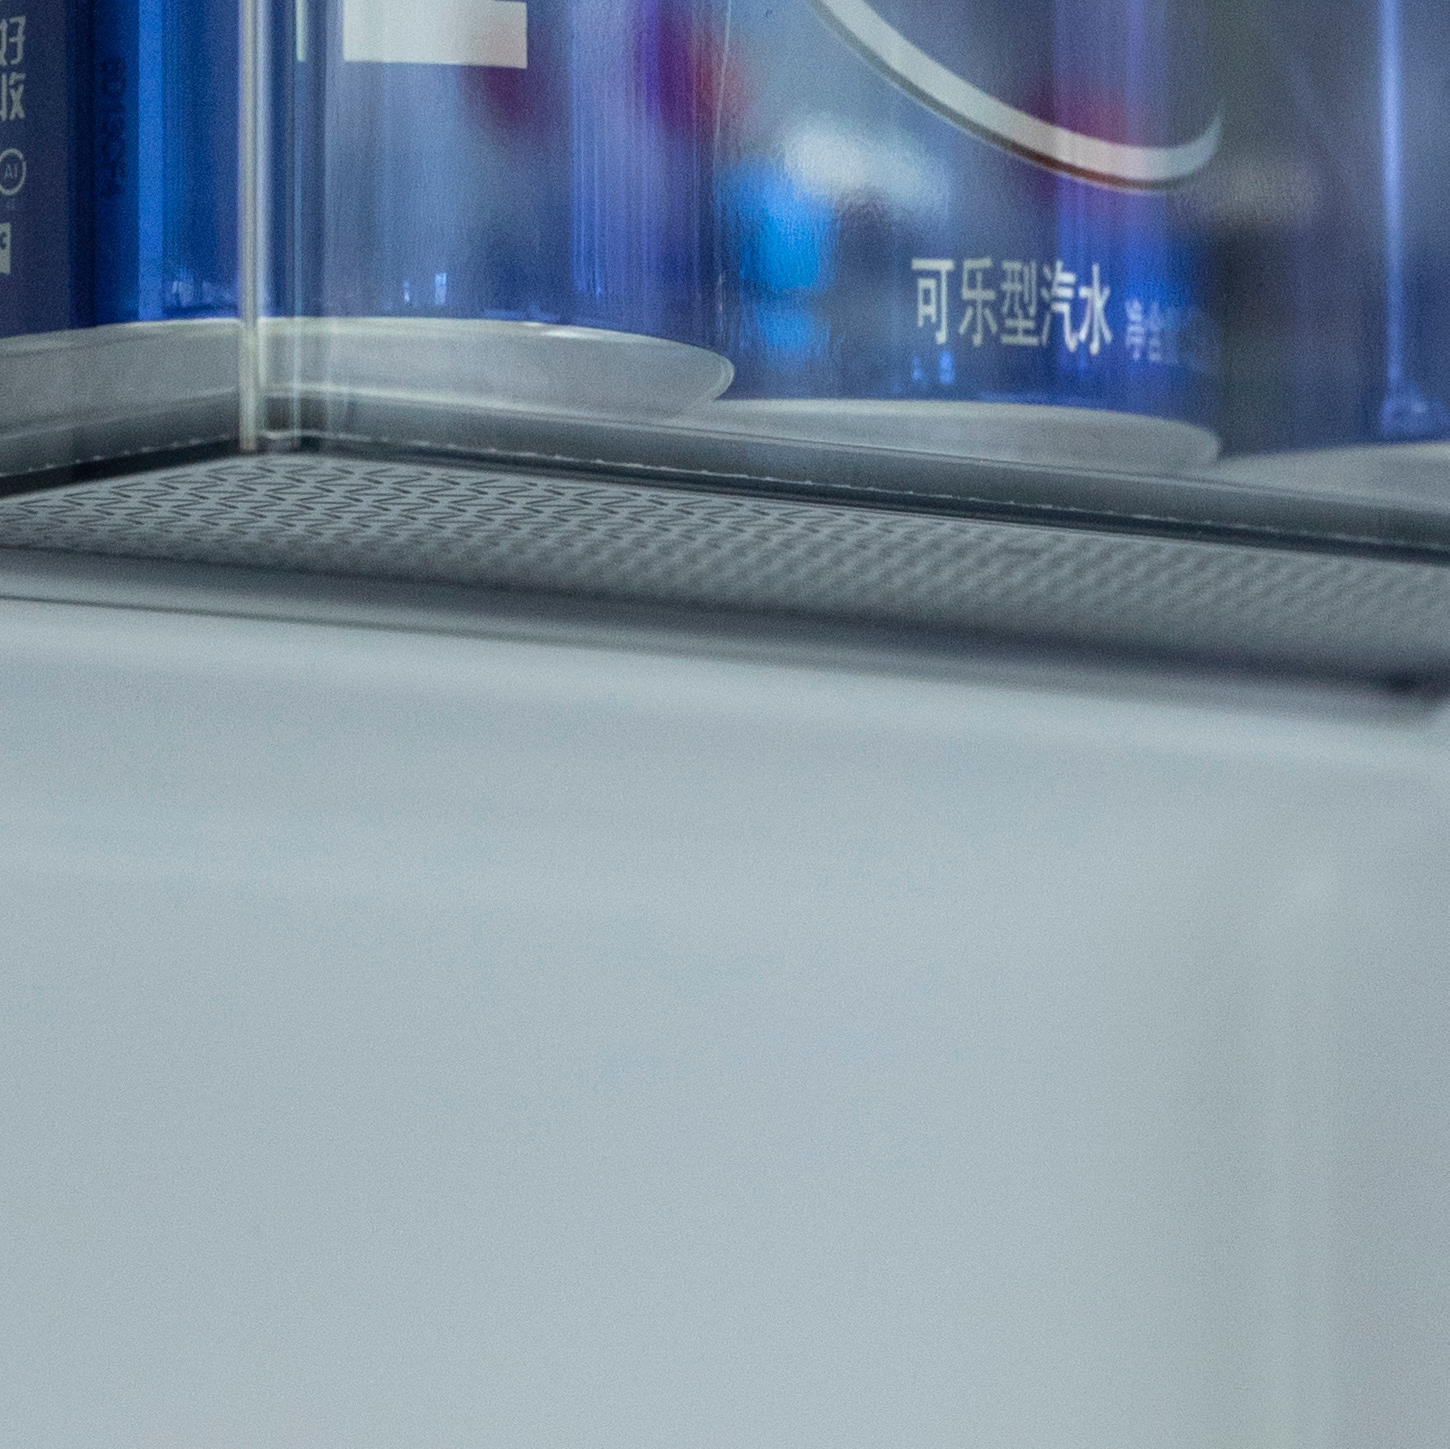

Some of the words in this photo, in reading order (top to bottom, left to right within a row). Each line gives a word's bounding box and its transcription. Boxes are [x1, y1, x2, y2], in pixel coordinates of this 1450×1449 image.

[911, 255, 1113, 354] 可乐型汽水
